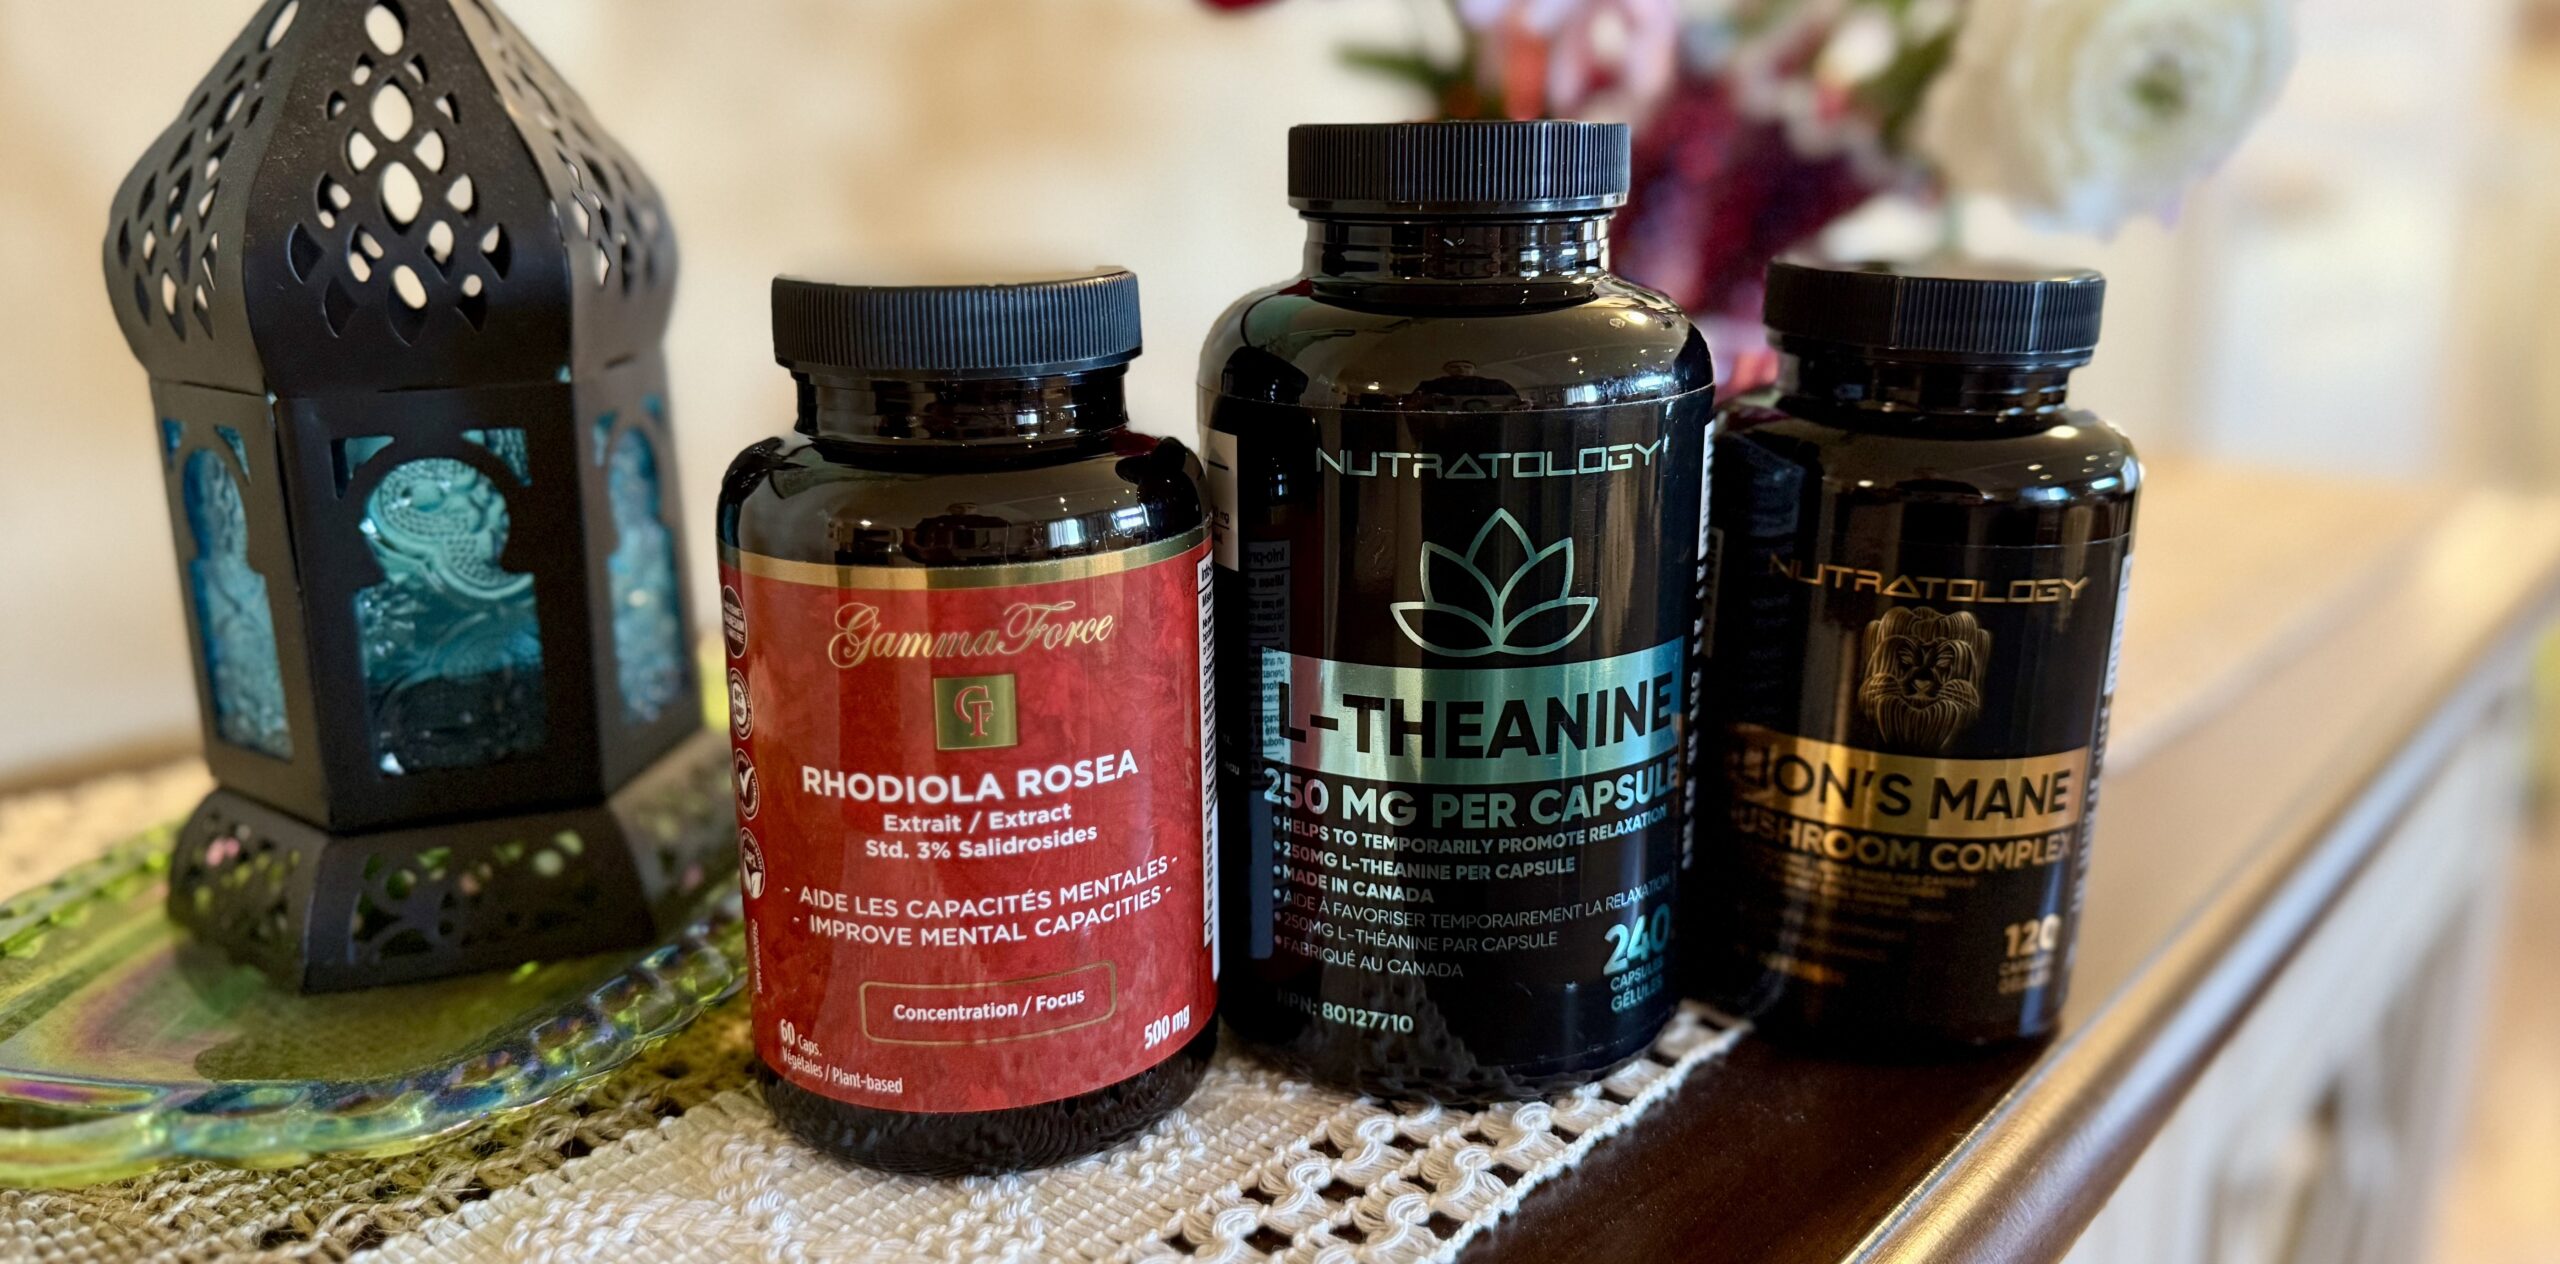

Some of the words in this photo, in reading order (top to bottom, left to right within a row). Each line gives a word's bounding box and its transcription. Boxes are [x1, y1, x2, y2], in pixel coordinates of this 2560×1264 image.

[1315, 439, 1662, 480] NUTRATOLOGY
[1768, 553, 2090, 603] NUTRATOLOGY
[1278, 670, 1674, 760] L-THEANINE
[802, 765, 1004, 804] RHODIOLA
[1018, 750, 1139, 798] ROSEA
[1264, 767, 1330, 815] 250
[1341, 785, 1417, 827] MG
[1432, 793, 1517, 829] PER
[1528, 754, 1680, 827] CAPSULE
[1928, 769, 2071, 822] MANE
[883, 814, 962, 833] Extrait
[968, 811, 982, 835] /
[989, 803, 1072, 829] Extract
[1282, 816, 1330, 842] HELPS
[1333, 828, 1358, 847] TO
[1361, 833, 1494, 855] TEMPORARILY
[1498, 829, 1586, 855] PROMOTE
[1588, 802, 1668, 843] RELAXATION
[865, 838, 911, 860] Std.
[916, 842, 952, 860] 3%
[958, 824, 1098, 860] Salidrosides
[1282, 840, 1338, 868] 250MG
[1342, 851, 1451, 881] L-THEANINE
[1455, 863, 1491, 881] PER
[1495, 856, 1576, 880] CAPSULE
[1929, 830, 2073, 875] COMPLEX
[800, 886, 849, 912] AIDE
[855, 898, 898, 918] LES
[906, 888, 1052, 920] CAPACITÉS
[1059, 860, 1168, 904] MENTALES
[1282, 864, 1328, 890] MADE
[1331, 876, 1349, 894] IN
[1352, 880, 1434, 904] CANADA
[1282, 888, 1317, 911] AIDE
[1318, 896, 1330, 915] À
[1332, 902, 1426, 928] FAVORISER
[1430, 904, 1585, 931] TEMPORAIREMENT
[1585, 899, 1603, 916] LA
[1605, 872, 1671, 912] RELAXATION
[809, 915, 912, 947] IMPROVE
[920, 924, 1028, 947] MENTAL
[1034, 887, 1161, 939] CAPACITIES
[1283, 911, 1335, 936] 250MG
[1337, 926, 1438, 952] L-THÉANINE
[1442, 935, 1477, 953] PAR
[1481, 930, 1559, 952] CAPSULE
[1602, 903, 1671, 976] 240
[2003, 913, 2061, 958] 120
[1283, 936, 1356, 968] FABRIQUÉ
[1359, 955, 1384, 972] AU
[1387, 958, 1464, 978] CANADA
[1610, 955, 1664, 992] CAPSULES
[892, 1000, 1019, 1023] Concentration
[1022, 995, 1032, 1017] /
[1035, 988, 1086, 1014] Focus
[1144, 1019, 1172, 1051] 500
[1172, 1004, 1191, 1037] mg
[1321, 1001, 1415, 1034] 80127710
[780, 1018, 796, 1045] 60
[797, 1033, 823, 1057] Caps.
[782, 1045, 824, 1078] Végétales
[824, 1063, 831, 1082] /
[831, 1066, 904, 1094] Plant-based
